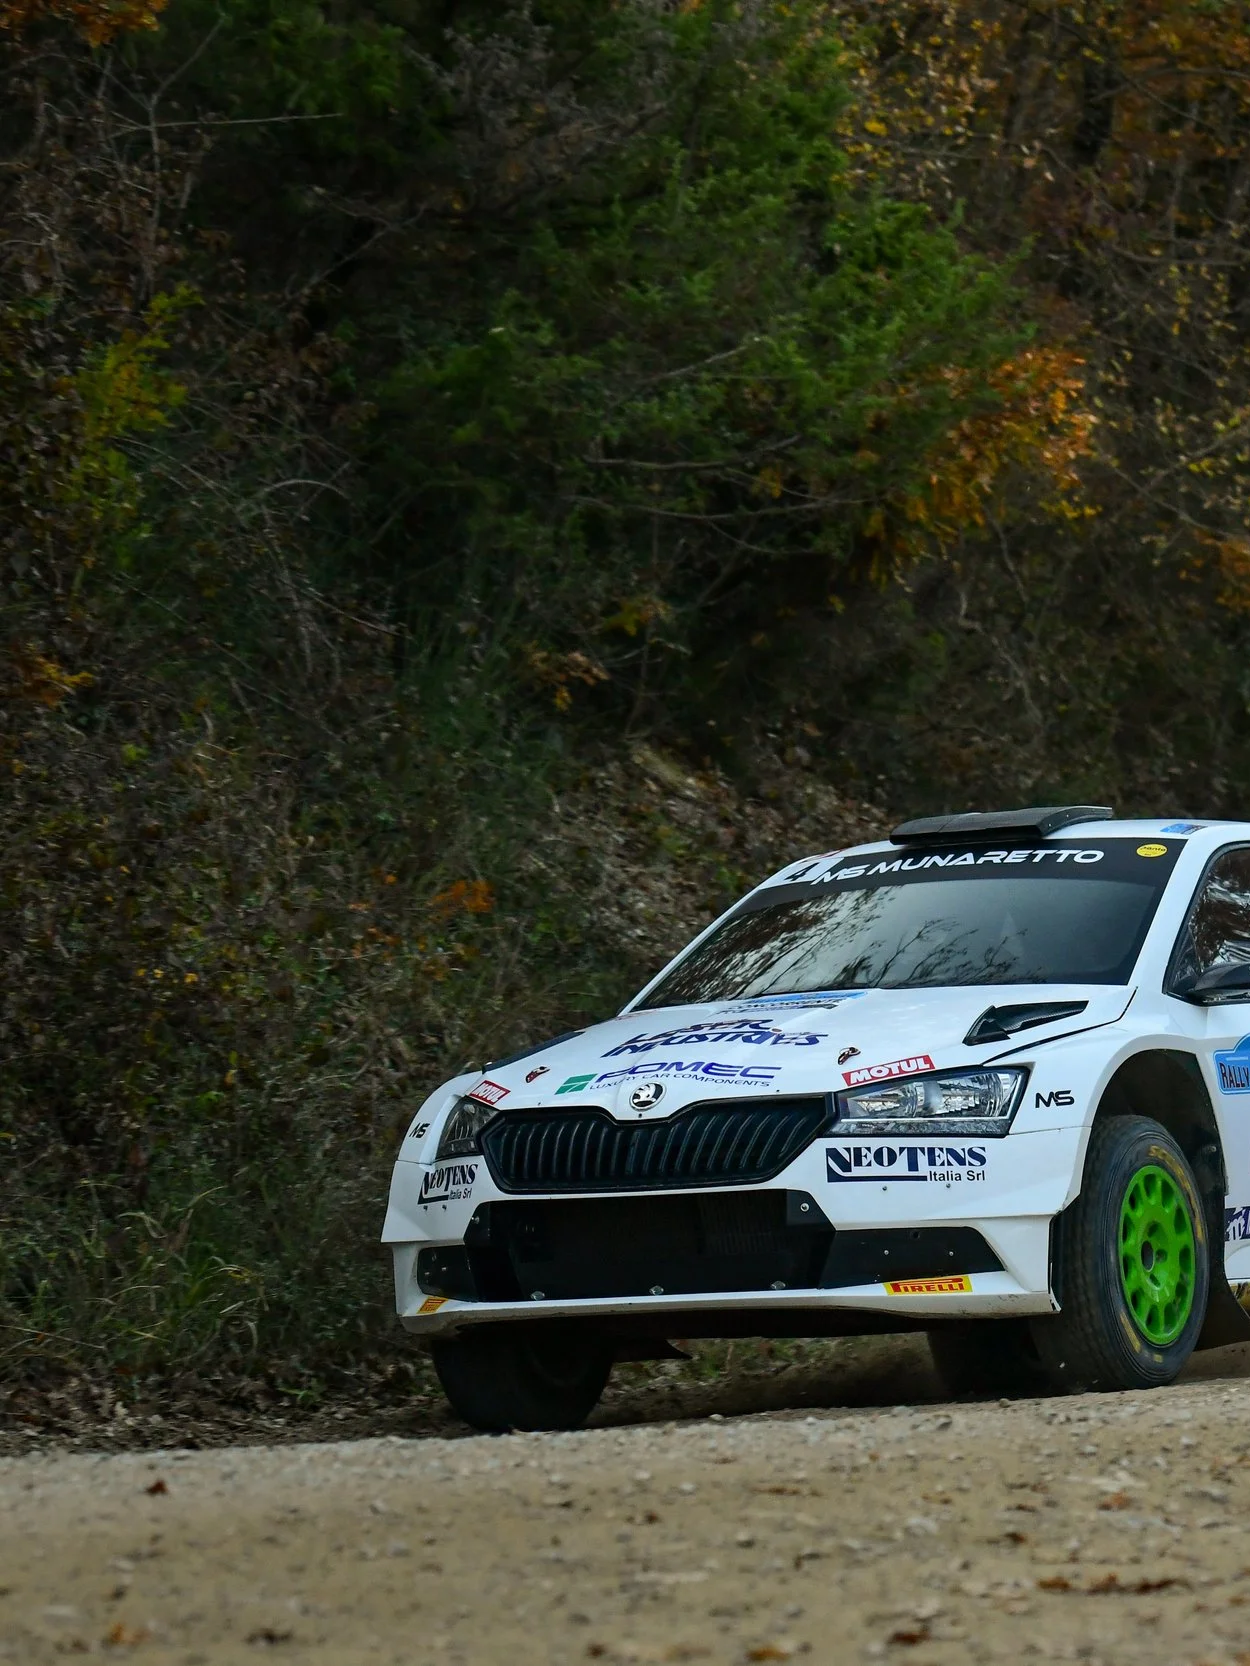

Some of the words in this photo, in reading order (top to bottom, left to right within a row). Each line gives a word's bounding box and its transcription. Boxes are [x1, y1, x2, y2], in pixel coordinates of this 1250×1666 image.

[810, 864, 870, 886] MS
[867, 849, 1104, 875] MUNARETTO
[622, 1019, 773, 1045] LASER
[600, 1031, 829, 1057] INDUSTRIES
[589, 1075, 639, 1089] LUXURY
[673, 1073, 772, 1088] COMPONENTS
[850, 1057, 930, 1085] MOTUL
[1219, 1062, 1249, 1088] RALLY
[472, 1083, 503, 1104] MOTUL
[1035, 1090, 1075, 1108] MS
[409, 1123, 430, 1138] MS
[826, 1147, 987, 1174] NEOTENS
[419, 1164, 478, 1197] NEOTENS
[929, 1169, 962, 1181] Italia
[966, 1169, 985, 1181] Srl
[449, 1189, 462, 1200] Italia
[463, 1188, 472, 1199] Srl
[890, 1278, 965, 1293] PIRELLI
